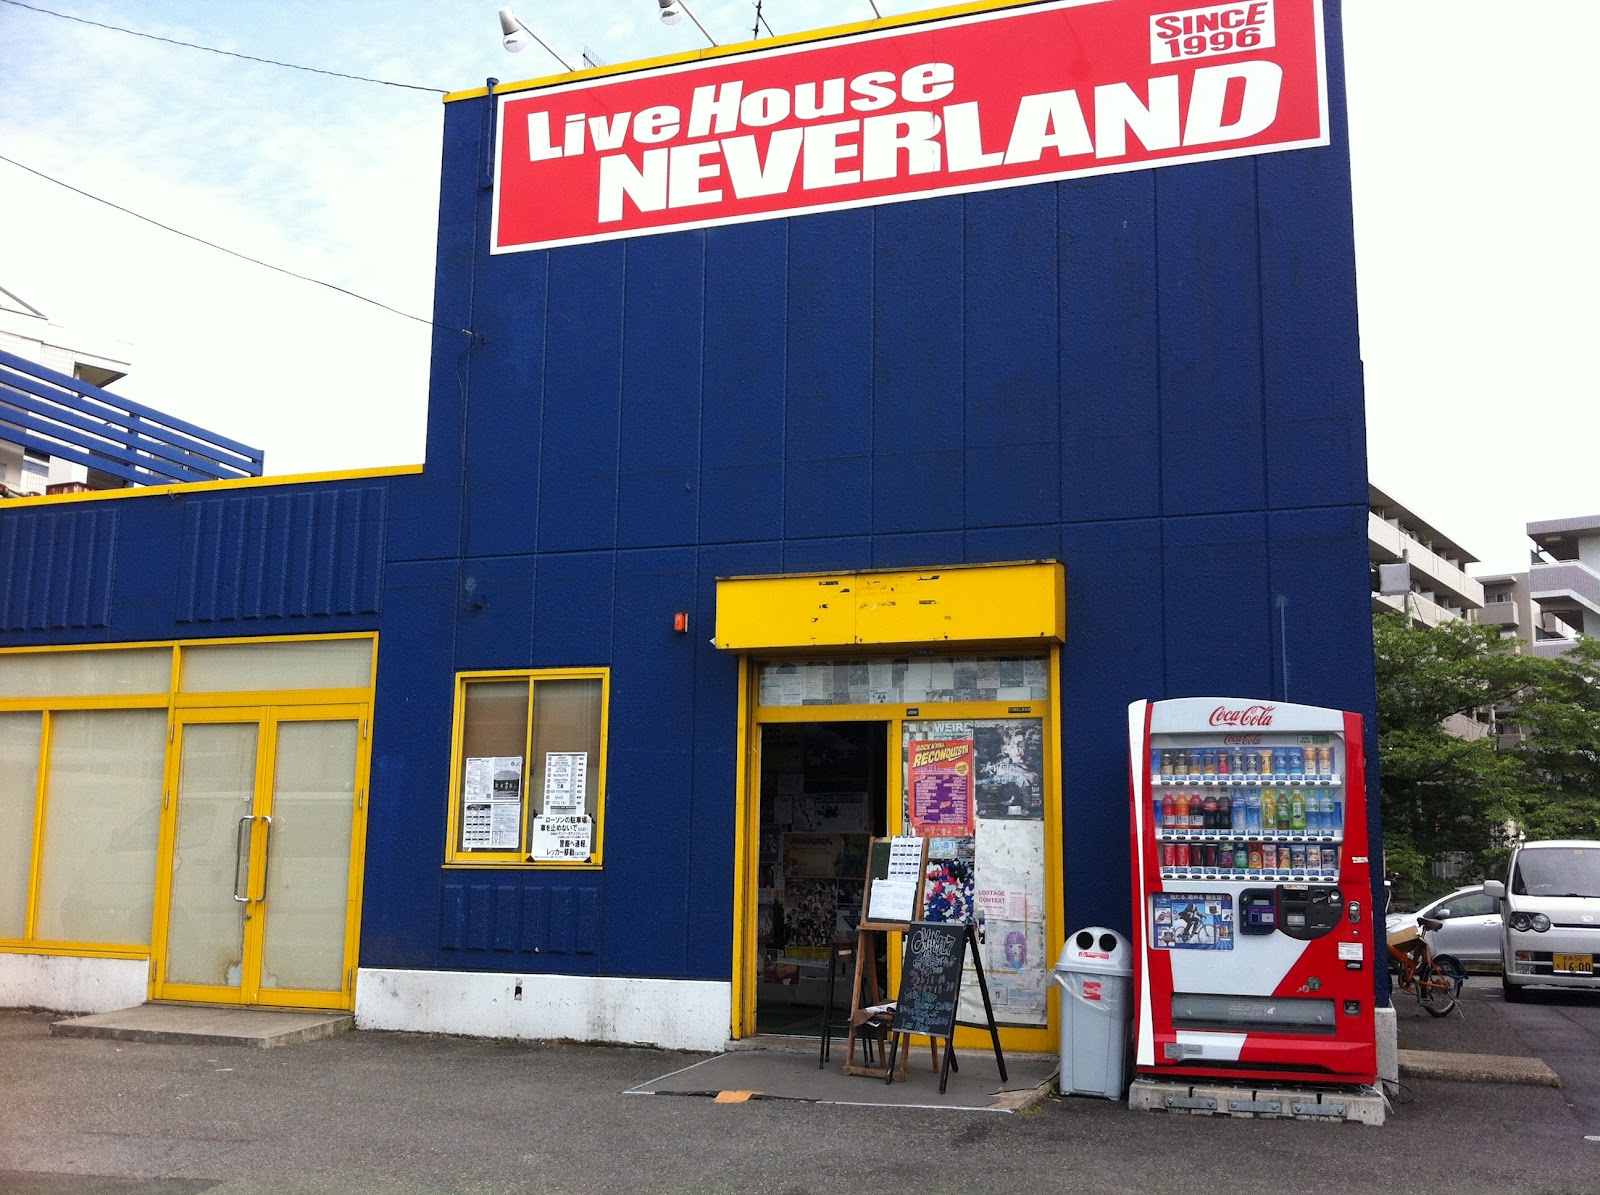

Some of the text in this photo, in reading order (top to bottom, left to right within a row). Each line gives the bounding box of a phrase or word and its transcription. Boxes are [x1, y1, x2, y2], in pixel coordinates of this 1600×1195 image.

[1155, 2, 1268, 39] SINCE
[1164, 27, 1261, 58] 1996
[527, 62, 955, 162] Live House
[597, 60, 1283, 223] NEVERLAND
[1209, 705, 1276, 726] Coca-Cola
[912, 744, 970, 768] RECONQUISTA
